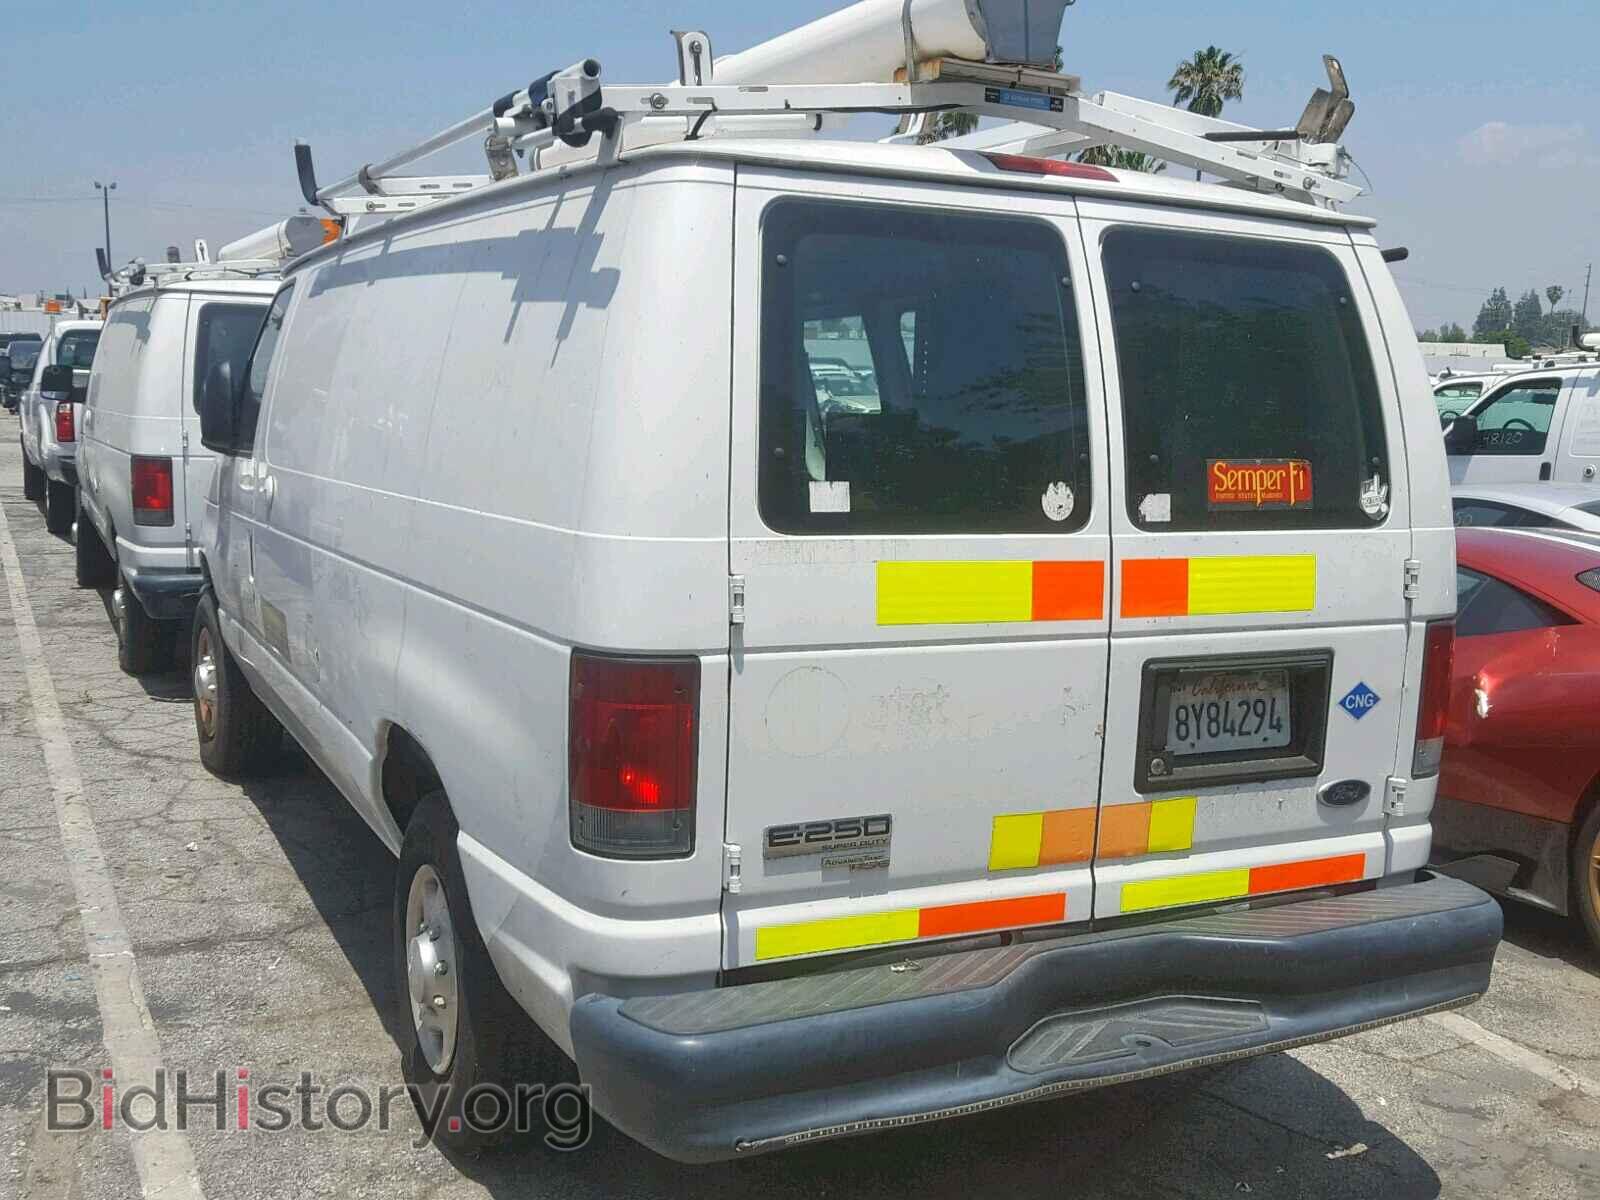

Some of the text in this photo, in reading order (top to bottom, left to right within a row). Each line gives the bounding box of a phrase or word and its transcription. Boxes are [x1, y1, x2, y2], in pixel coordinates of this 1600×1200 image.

[1213, 461, 1304, 507] Semper Fi
[1175, 698, 1282, 741] 8Y84294
[1345, 693, 1374, 709] CNG
